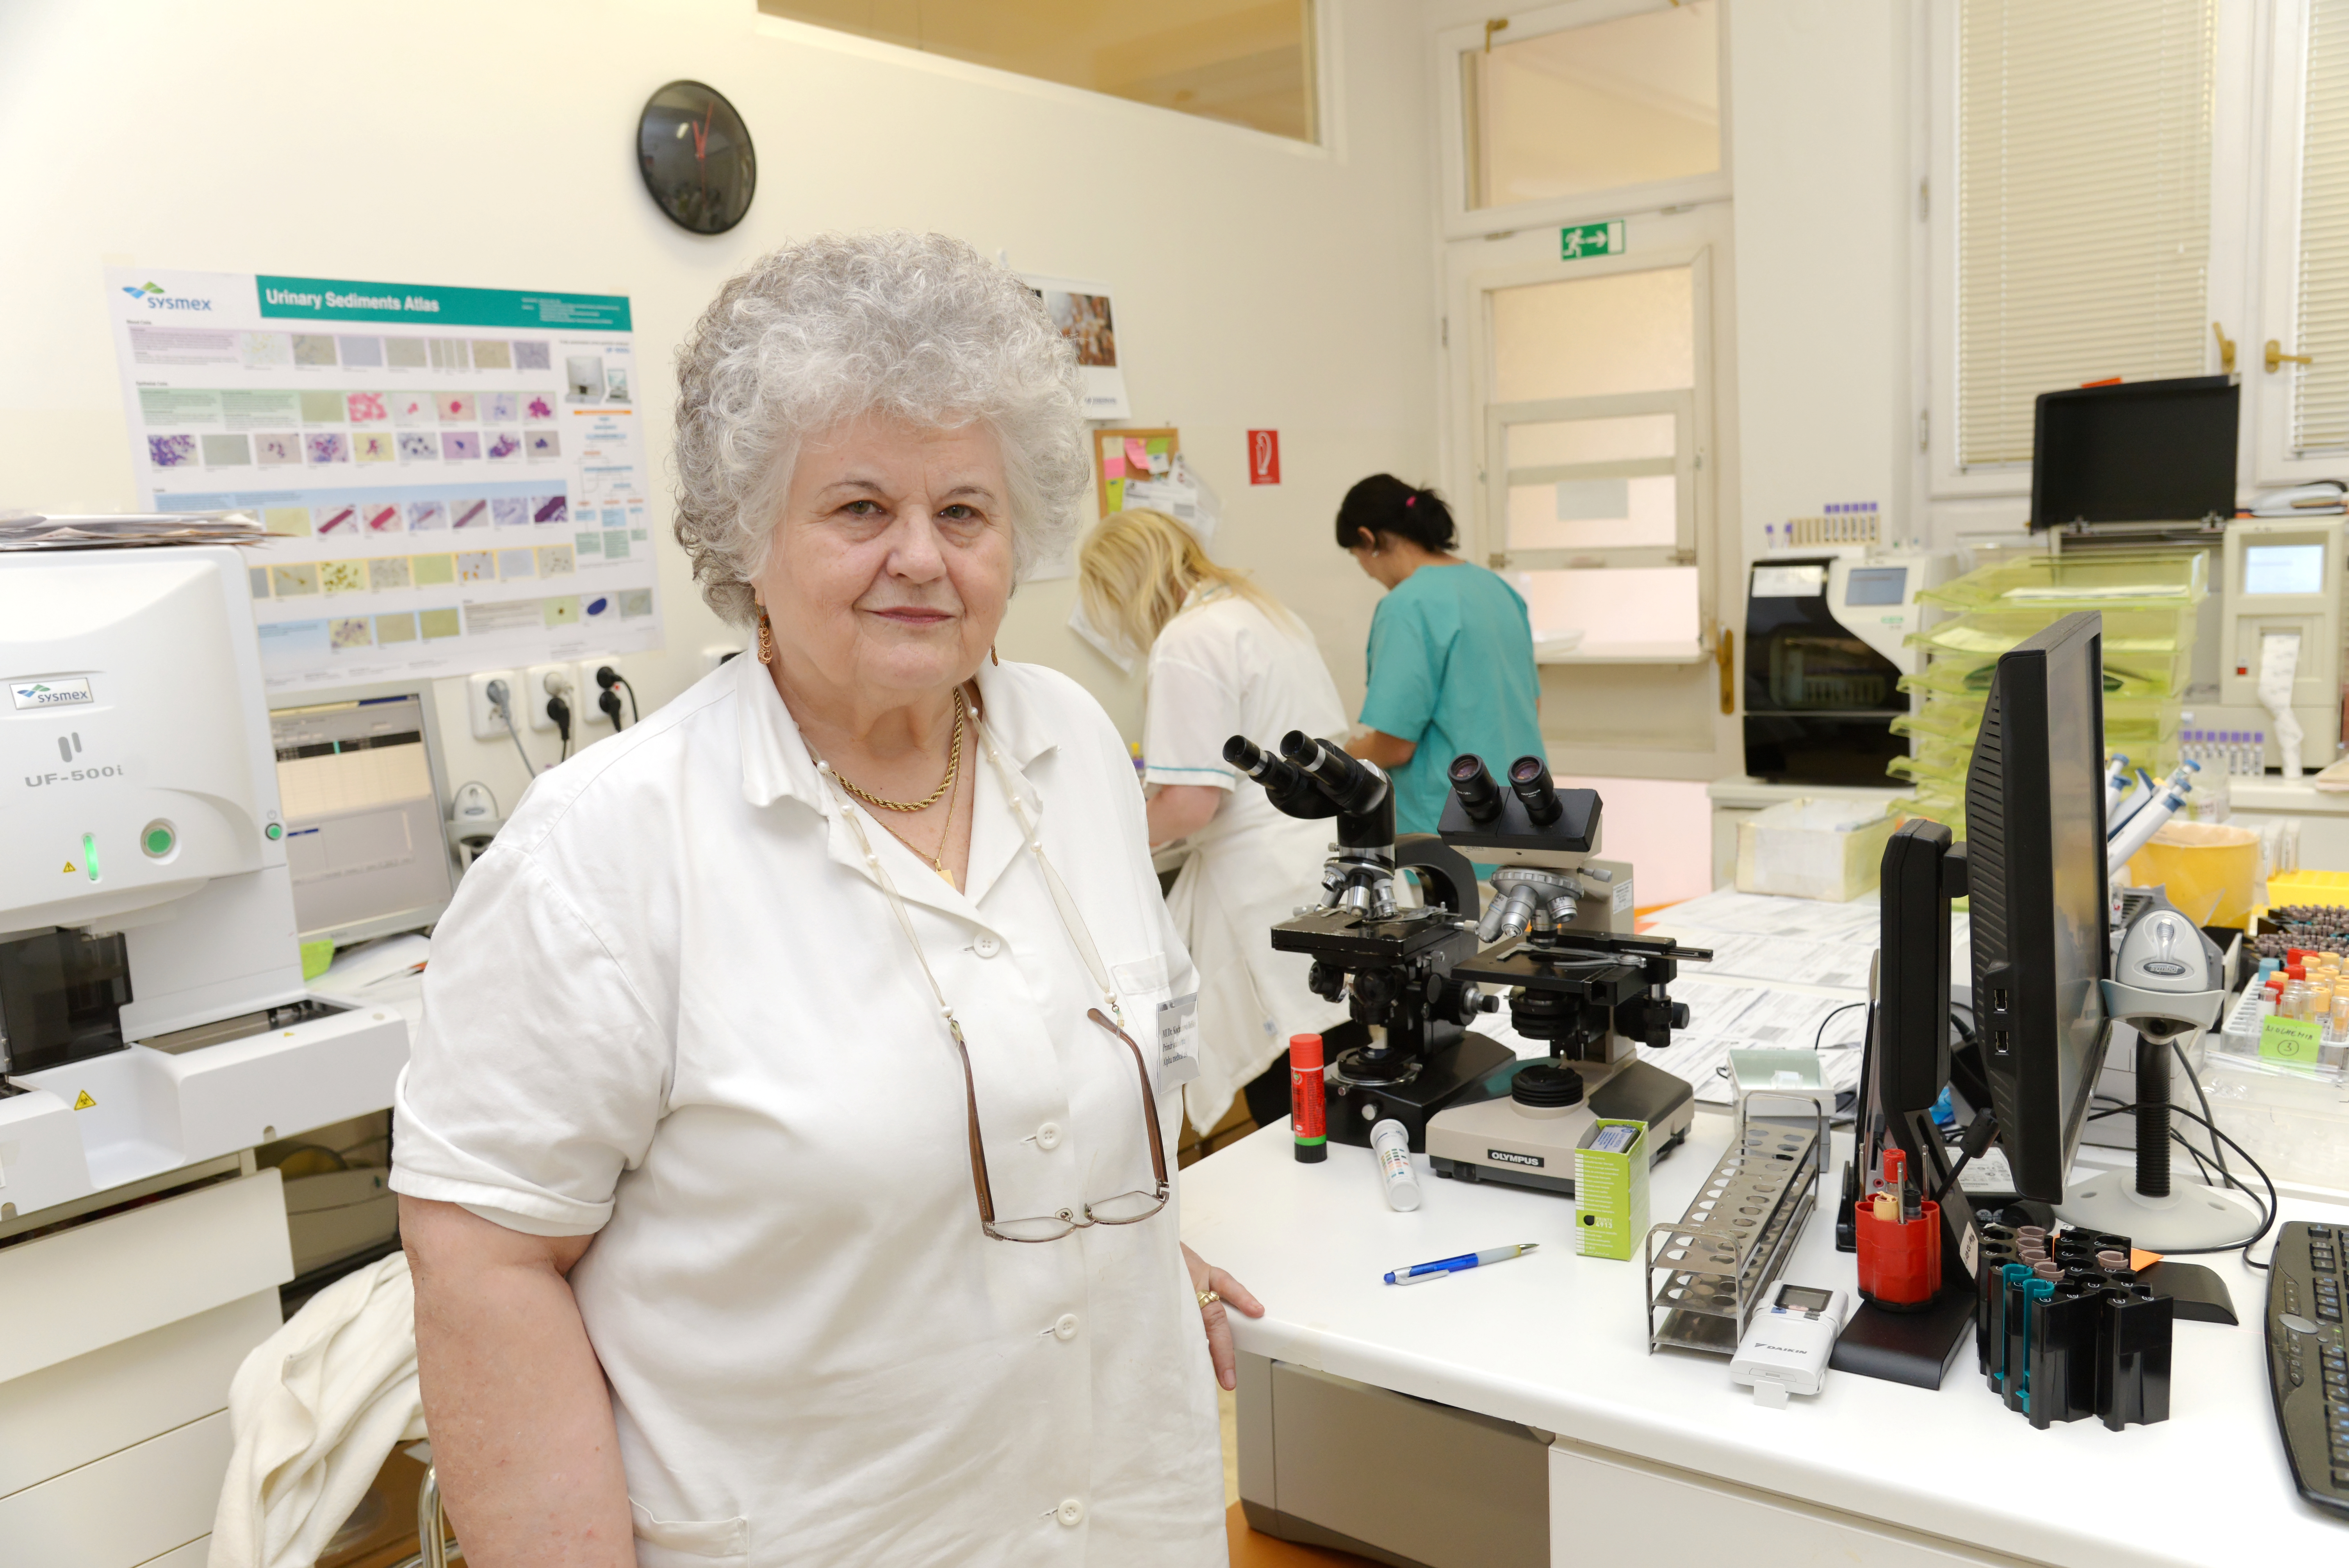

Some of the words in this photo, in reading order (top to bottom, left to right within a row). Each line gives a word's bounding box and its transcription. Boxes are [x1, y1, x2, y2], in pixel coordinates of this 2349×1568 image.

[147, 297, 213, 311] sysmex
[266, 288, 323, 310] Urinary
[326, 291, 401, 310] Sediments
[404, 296, 440, 312] Atlas
[38, 690, 88, 703] sysmex
[25, 765, 124, 788] UF-500i
[1163, 1056, 1172, 1067] Alpha
[1492, 1151, 1539, 1166] OLYMPUS
[1766, 1345, 1807, 1354] DAIKIN
